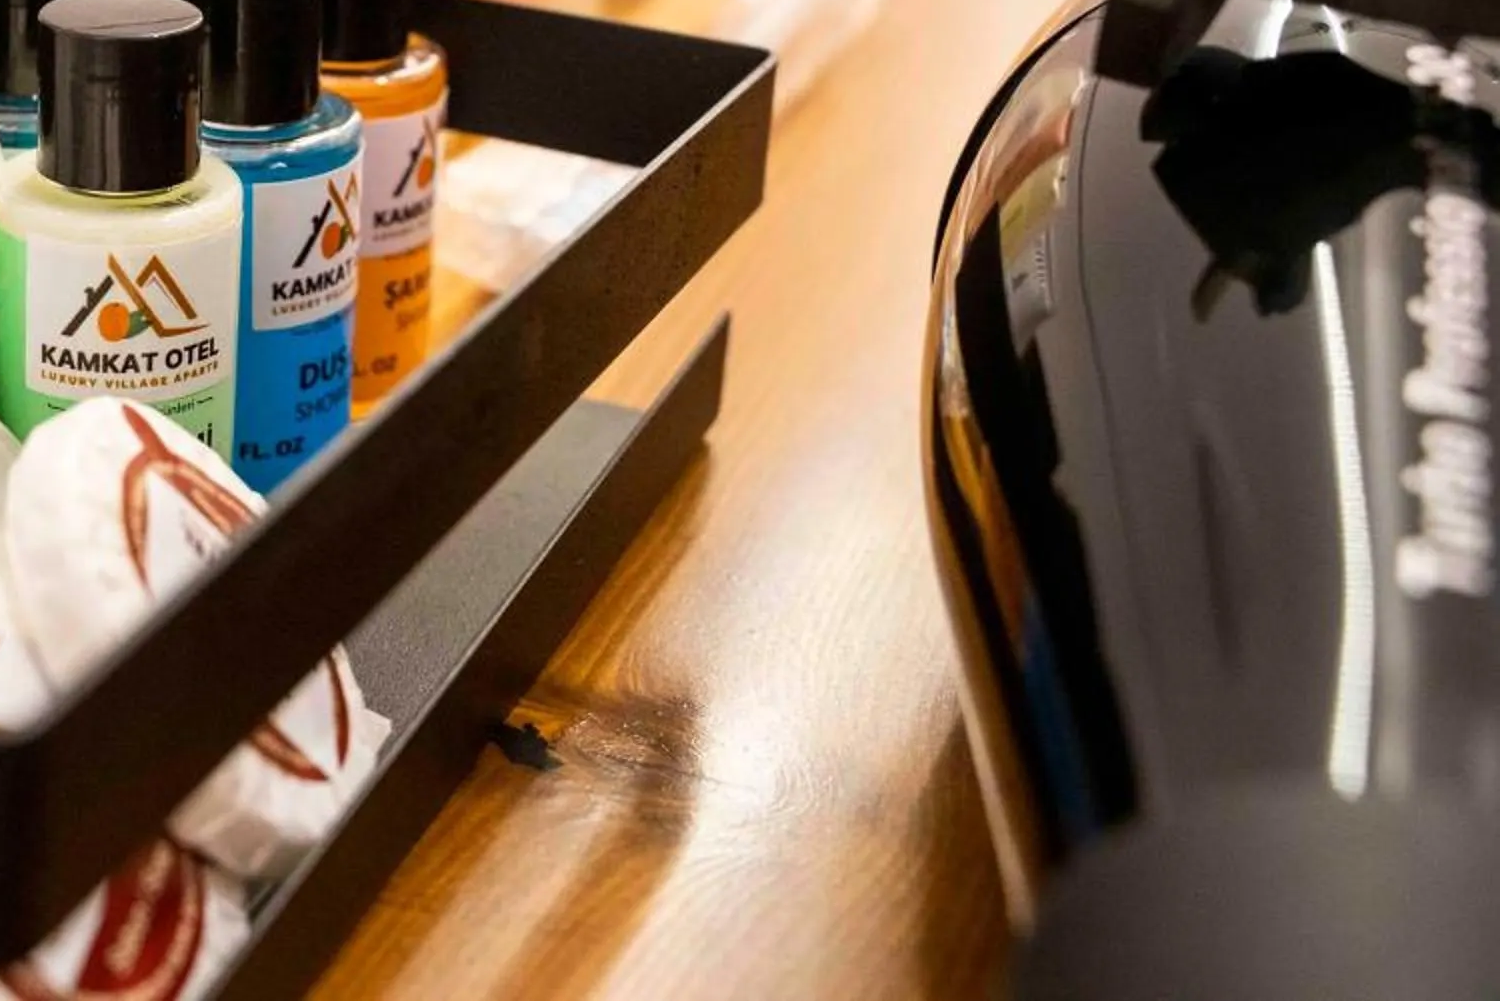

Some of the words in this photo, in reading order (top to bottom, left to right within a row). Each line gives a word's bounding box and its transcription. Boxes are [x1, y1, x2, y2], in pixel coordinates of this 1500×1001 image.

[41, 343, 159, 374] KAMKAT
[165, 336, 219, 370] OTEL
[41, 369, 97, 388] LUXURY
[105, 376, 168, 390] VILLAGE
[276, 435, 306, 457] OZ
